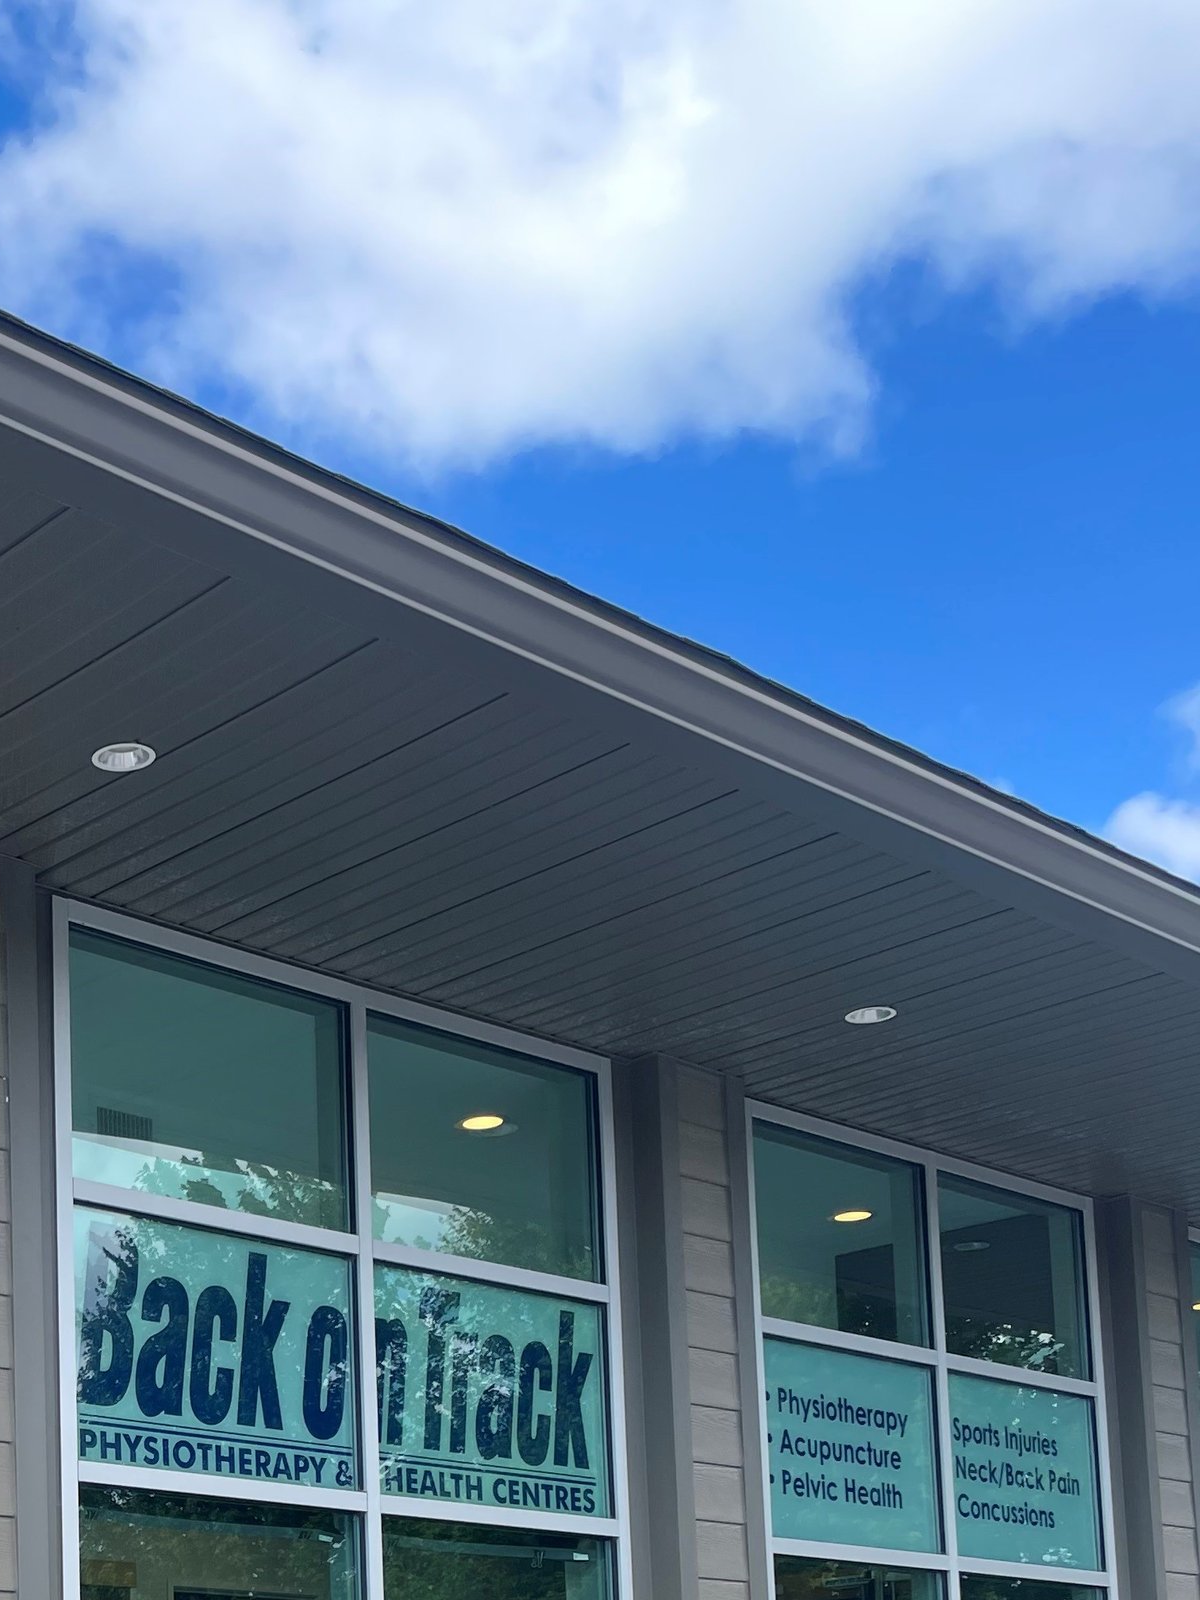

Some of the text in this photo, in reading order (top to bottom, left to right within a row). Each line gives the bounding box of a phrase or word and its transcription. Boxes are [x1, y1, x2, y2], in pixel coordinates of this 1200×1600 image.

[77, 1221, 290, 1430] Back
[419, 1286, 594, 1469] Track
[777, 1387, 908, 1438] Physiotherapy
[780, 1429, 901, 1469] Acupuncture
[953, 1417, 1057, 1457] Sports Injuries
[79, 1428, 596, 1514] PHYSIOTHERAPY & HEALTH CENTRES
[782, 1470, 903, 1509] Pelvic Health
[955, 1455, 1080, 1496] Neck/Back Pain
[957, 1493, 1055, 1528] Concussions
